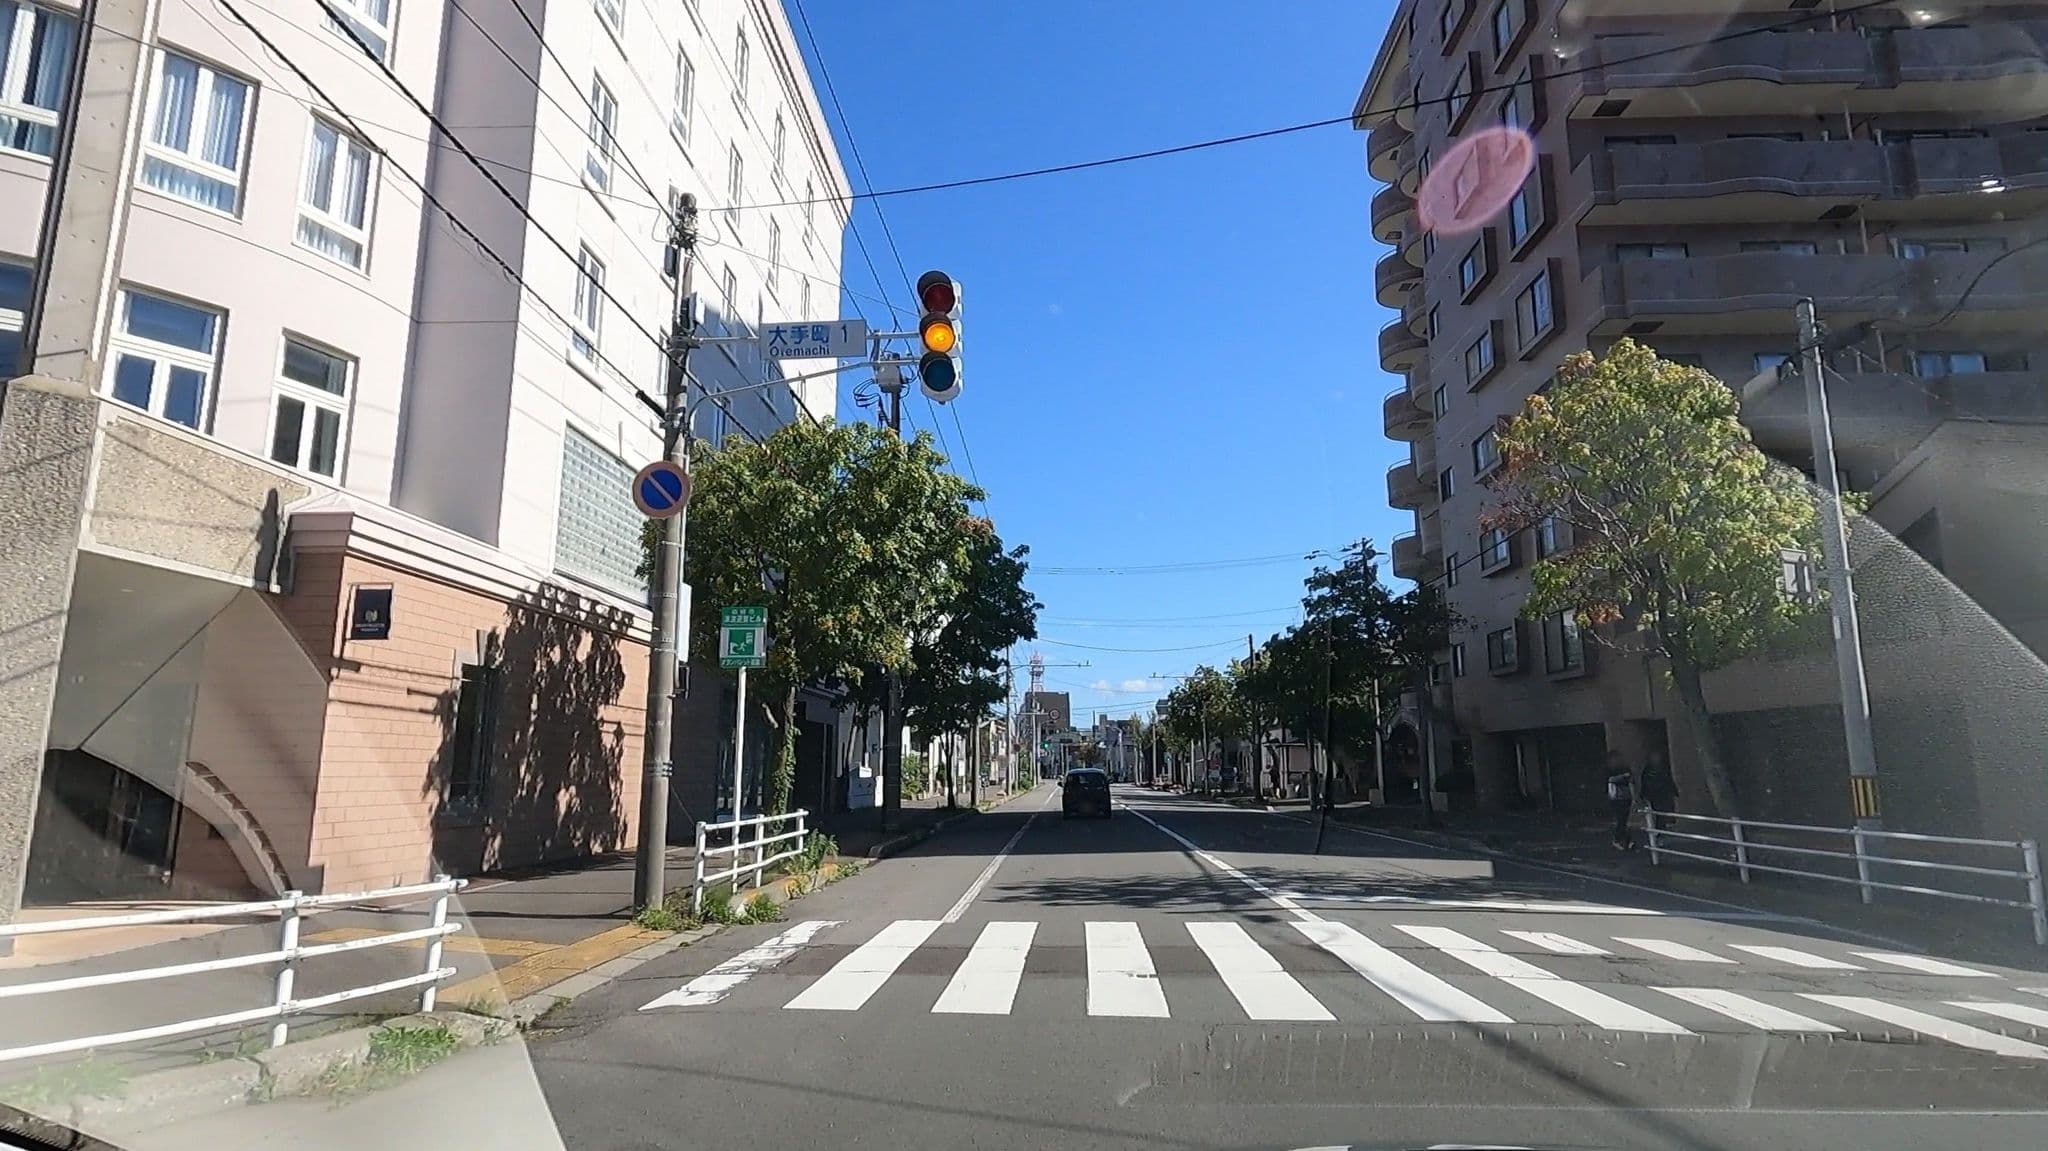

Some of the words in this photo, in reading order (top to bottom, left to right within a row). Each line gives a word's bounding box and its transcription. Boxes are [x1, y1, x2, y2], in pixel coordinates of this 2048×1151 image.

[768, 325, 830, 346] 大手町
[841, 324, 848, 343] 1
